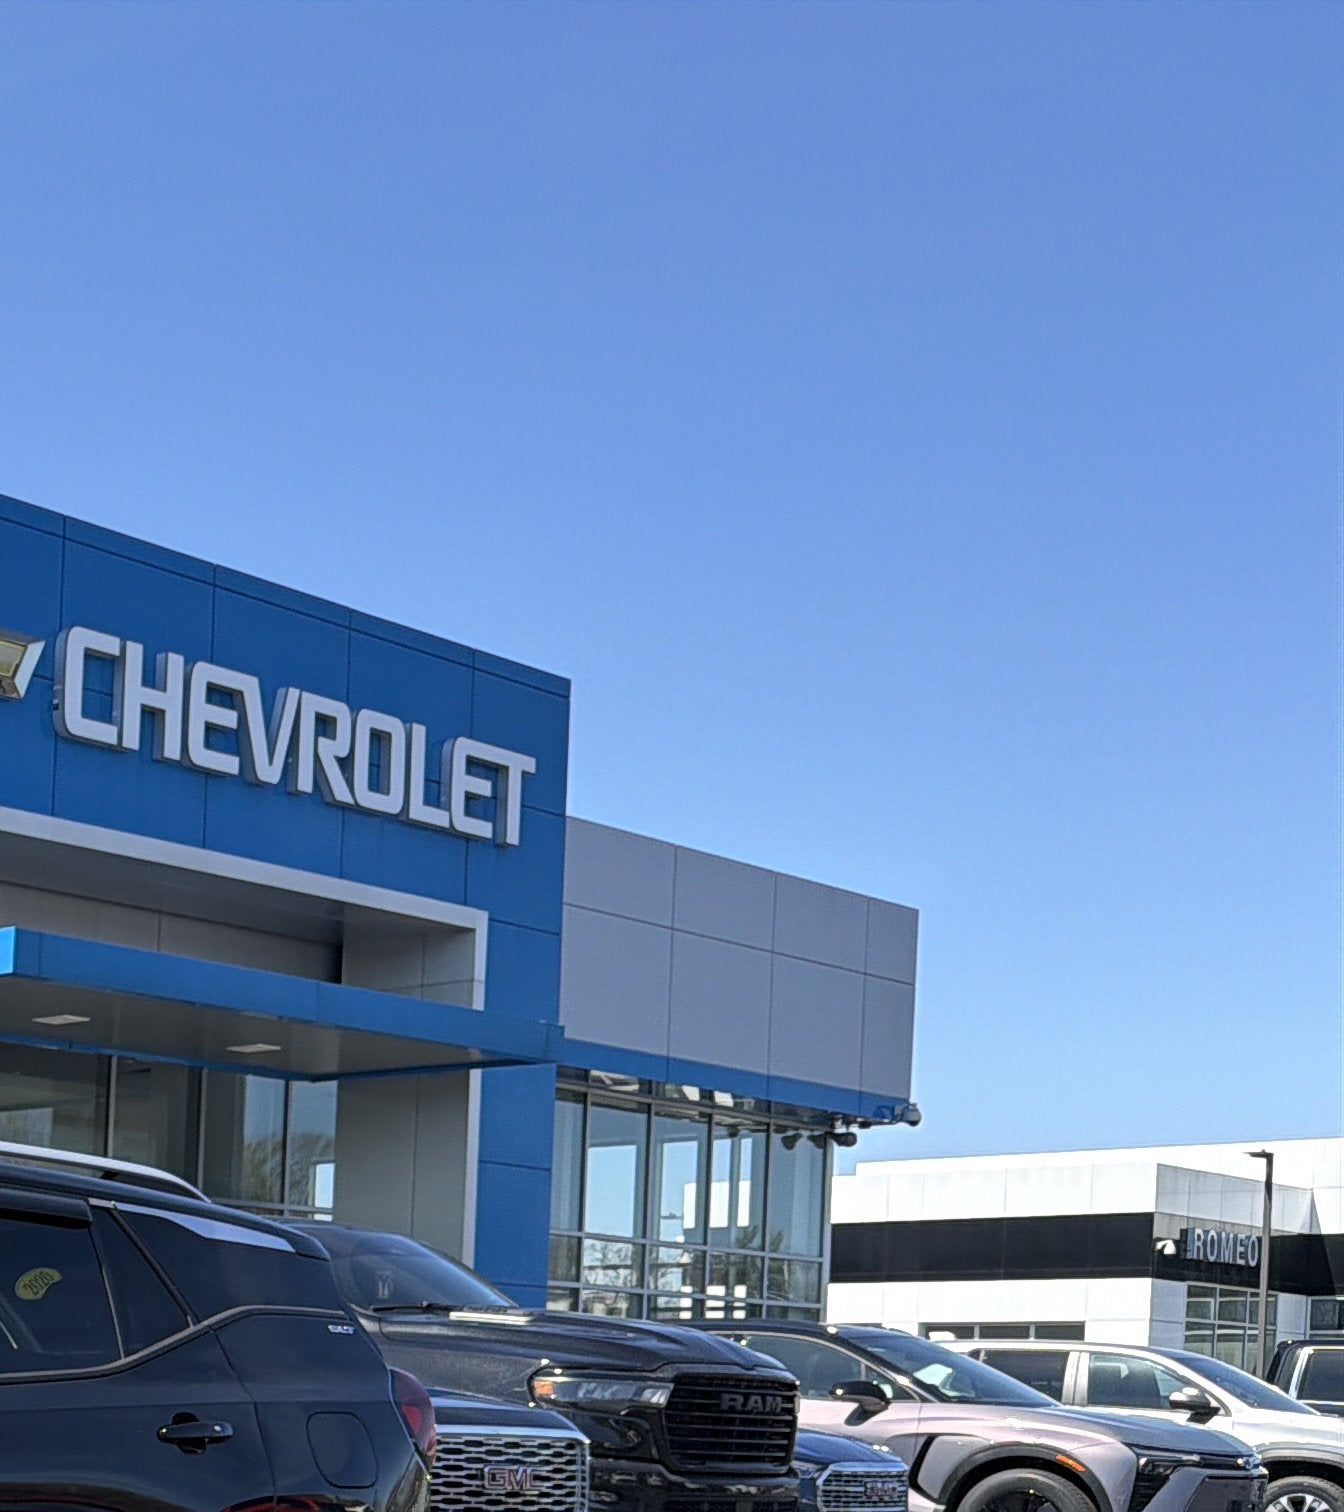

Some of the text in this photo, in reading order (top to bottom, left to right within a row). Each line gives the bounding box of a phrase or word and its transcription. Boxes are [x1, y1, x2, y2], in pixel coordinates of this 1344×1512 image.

[53, 626, 537, 847] CHEVROLET
[1189, 1227, 1259, 1268] ROMEO
[720, 1393, 782, 1413] RAM
[484, 1463, 547, 1492] GMC
